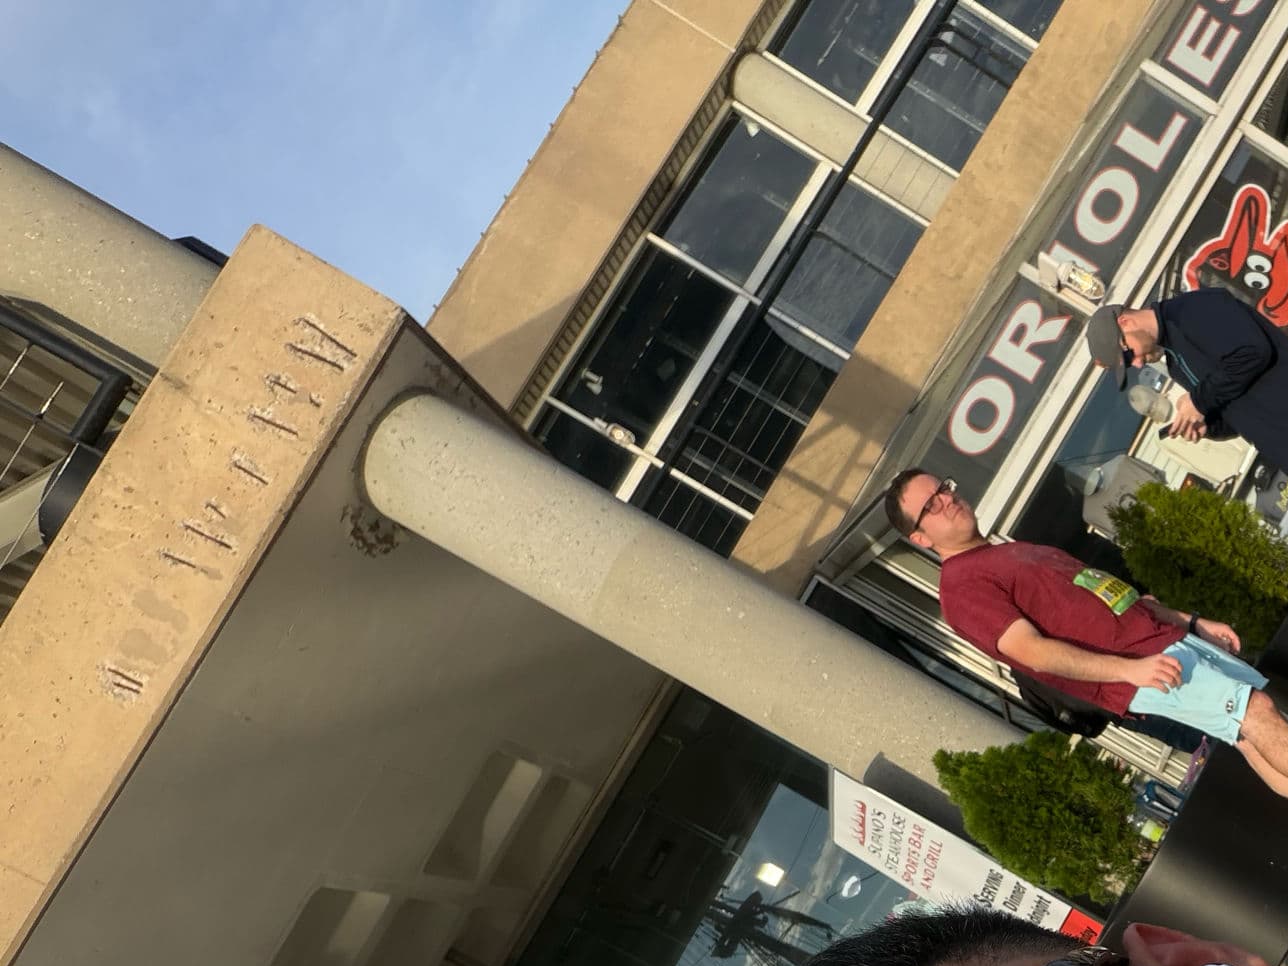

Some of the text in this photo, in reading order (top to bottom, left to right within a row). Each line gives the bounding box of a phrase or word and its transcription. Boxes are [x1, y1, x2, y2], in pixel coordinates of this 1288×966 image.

[948, 0, 1262, 456] OROLE
[902, 823, 926, 886] SPORTS BAR
[921, 839, 943, 891] AND GRILL
[973, 868, 1004, 908] SERVING
[1003, 881, 1027, 912] Dinner
